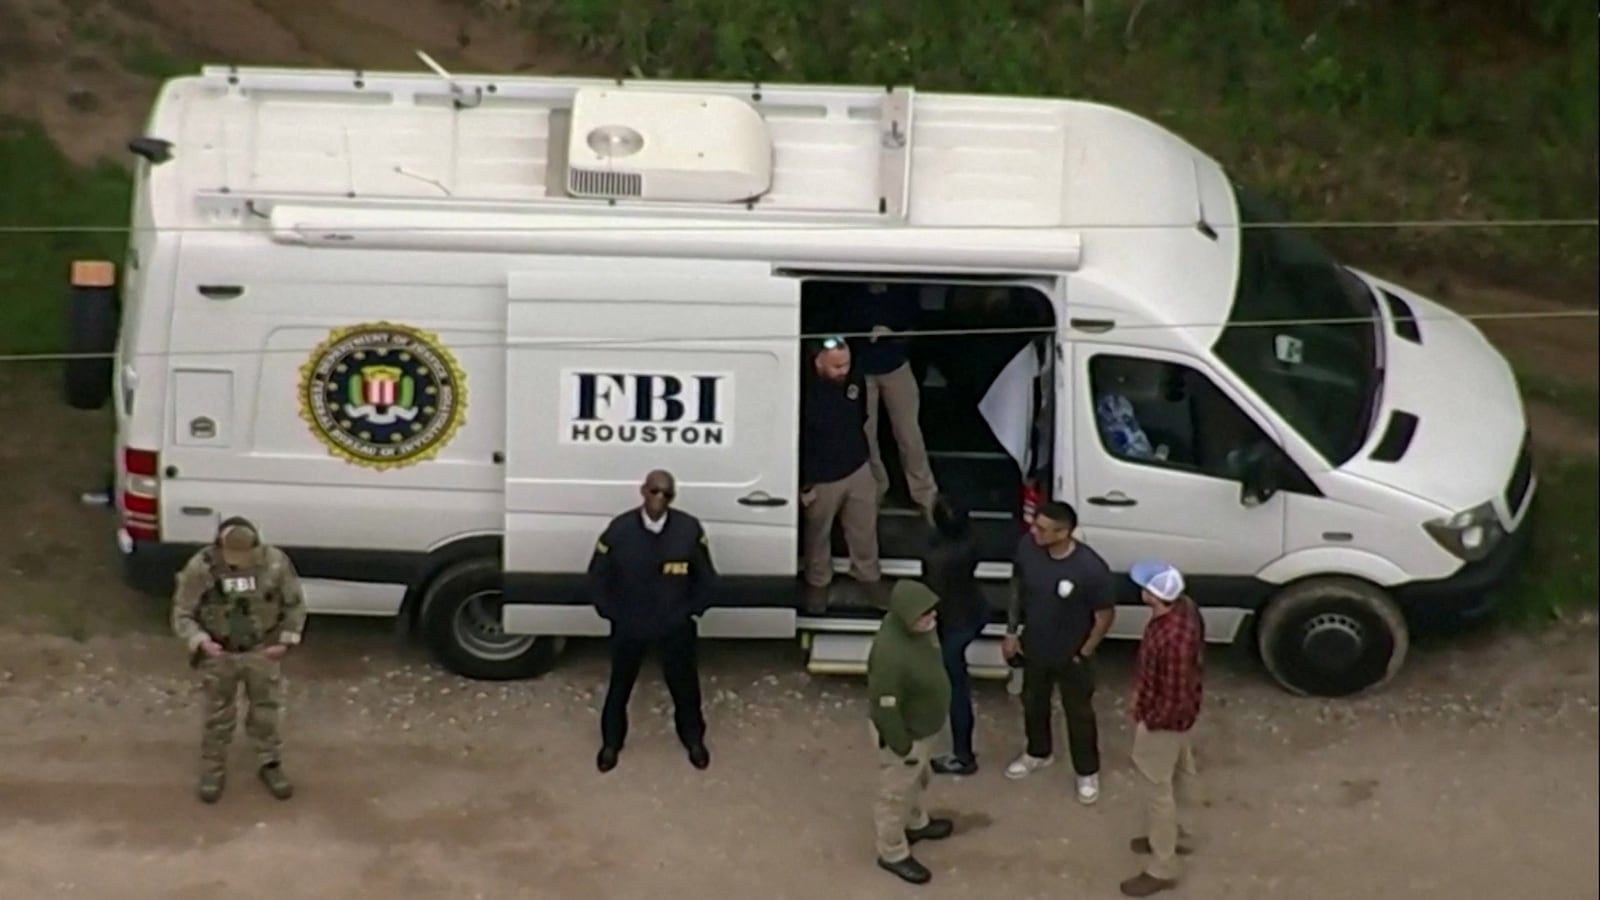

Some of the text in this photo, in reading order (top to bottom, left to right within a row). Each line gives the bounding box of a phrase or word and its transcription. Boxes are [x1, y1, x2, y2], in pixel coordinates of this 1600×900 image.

[571, 372, 726, 424] FBI
[571, 424, 723, 445] HOUSTON
[662, 561, 689, 575] FBI
